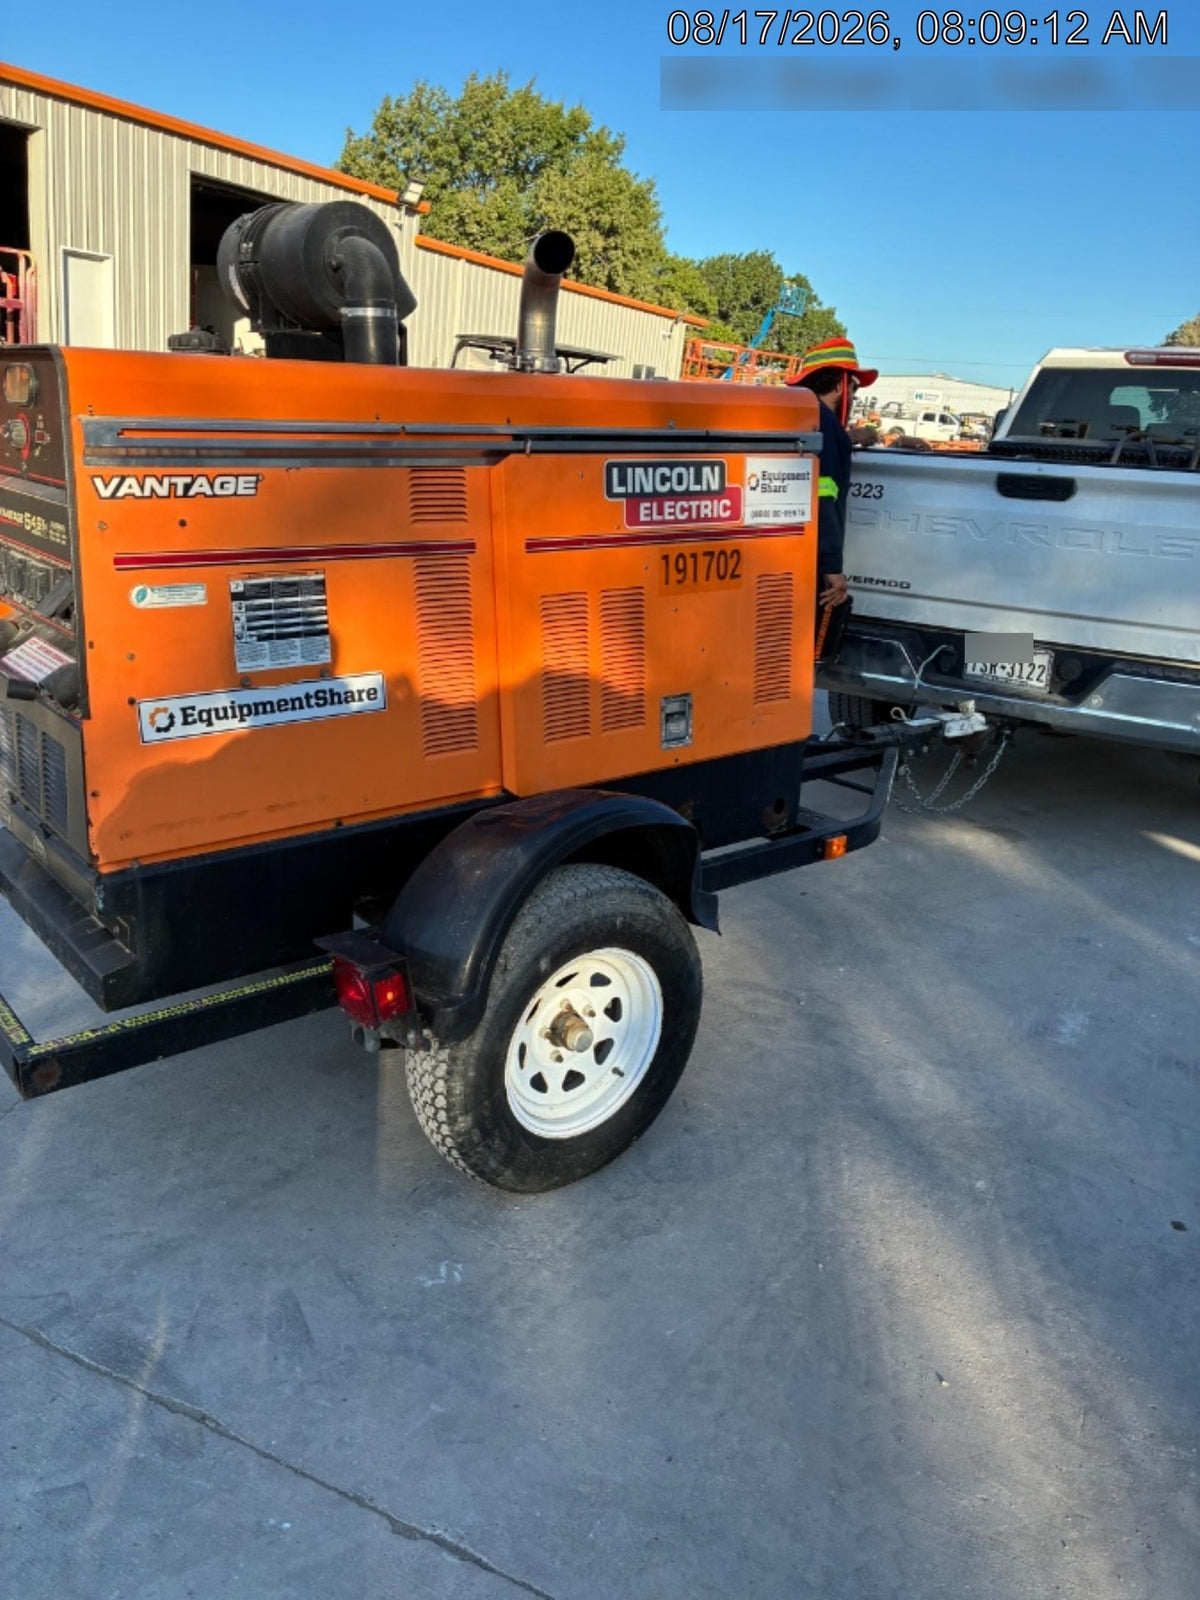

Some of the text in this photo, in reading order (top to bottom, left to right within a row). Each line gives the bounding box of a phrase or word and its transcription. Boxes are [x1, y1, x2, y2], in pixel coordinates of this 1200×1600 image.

[91, 474, 259, 498] VANTAGE
[611, 465, 720, 493] LINCOLN
[761, 470, 810, 484] Equipment
[761, 483, 788, 493] Share
[639, 499, 731, 522] ELECTRIC
[660, 549, 741, 586] 191702
[180, 687, 378, 727] EquipmentShare
